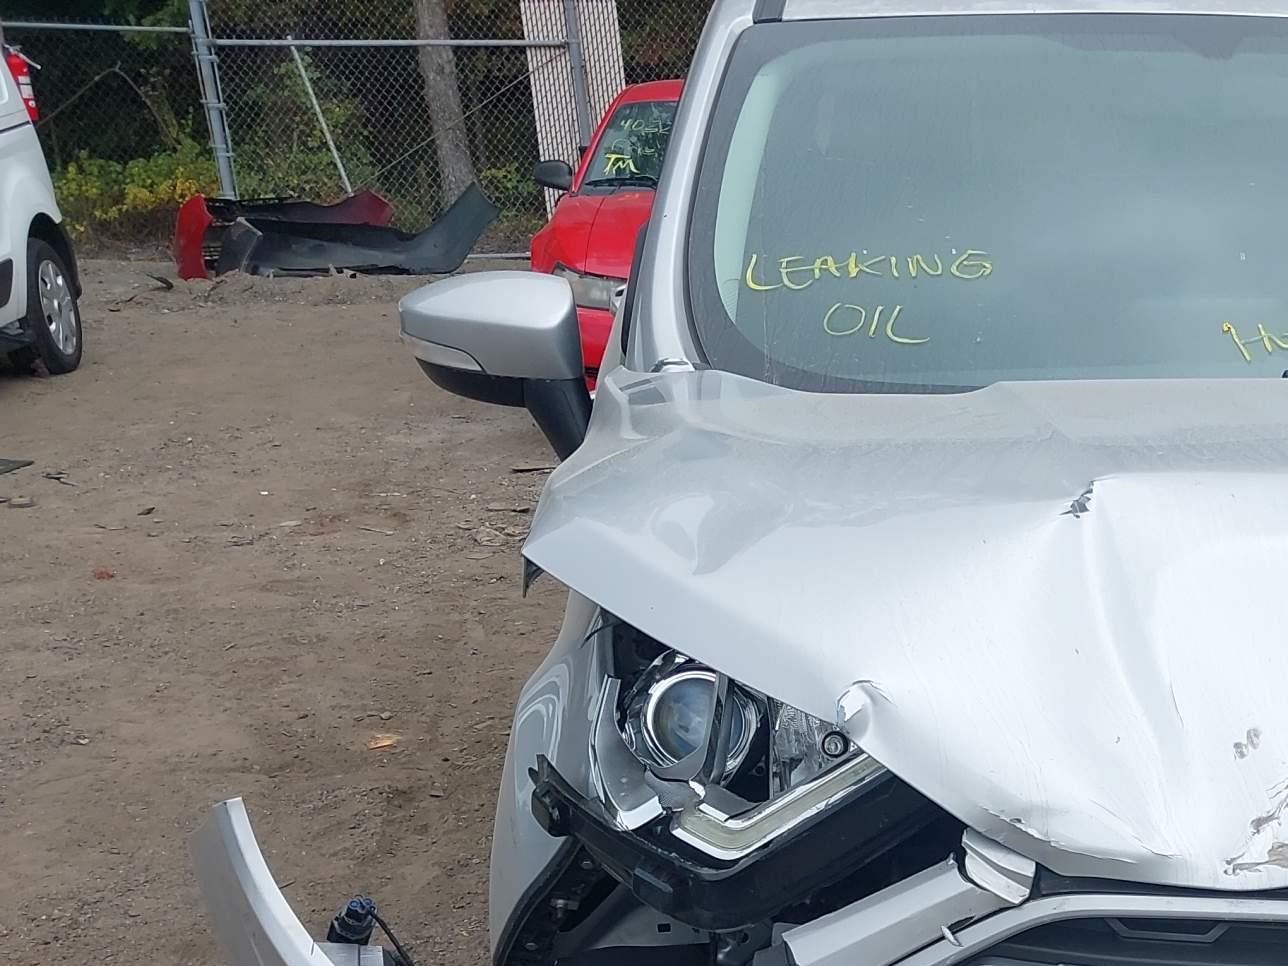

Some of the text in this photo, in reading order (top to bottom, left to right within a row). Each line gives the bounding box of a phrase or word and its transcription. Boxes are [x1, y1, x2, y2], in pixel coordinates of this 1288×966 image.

[603, 153, 641, 175] TM
[746, 249, 993, 290] LEAKING
[823, 302, 931, 344] OIL
